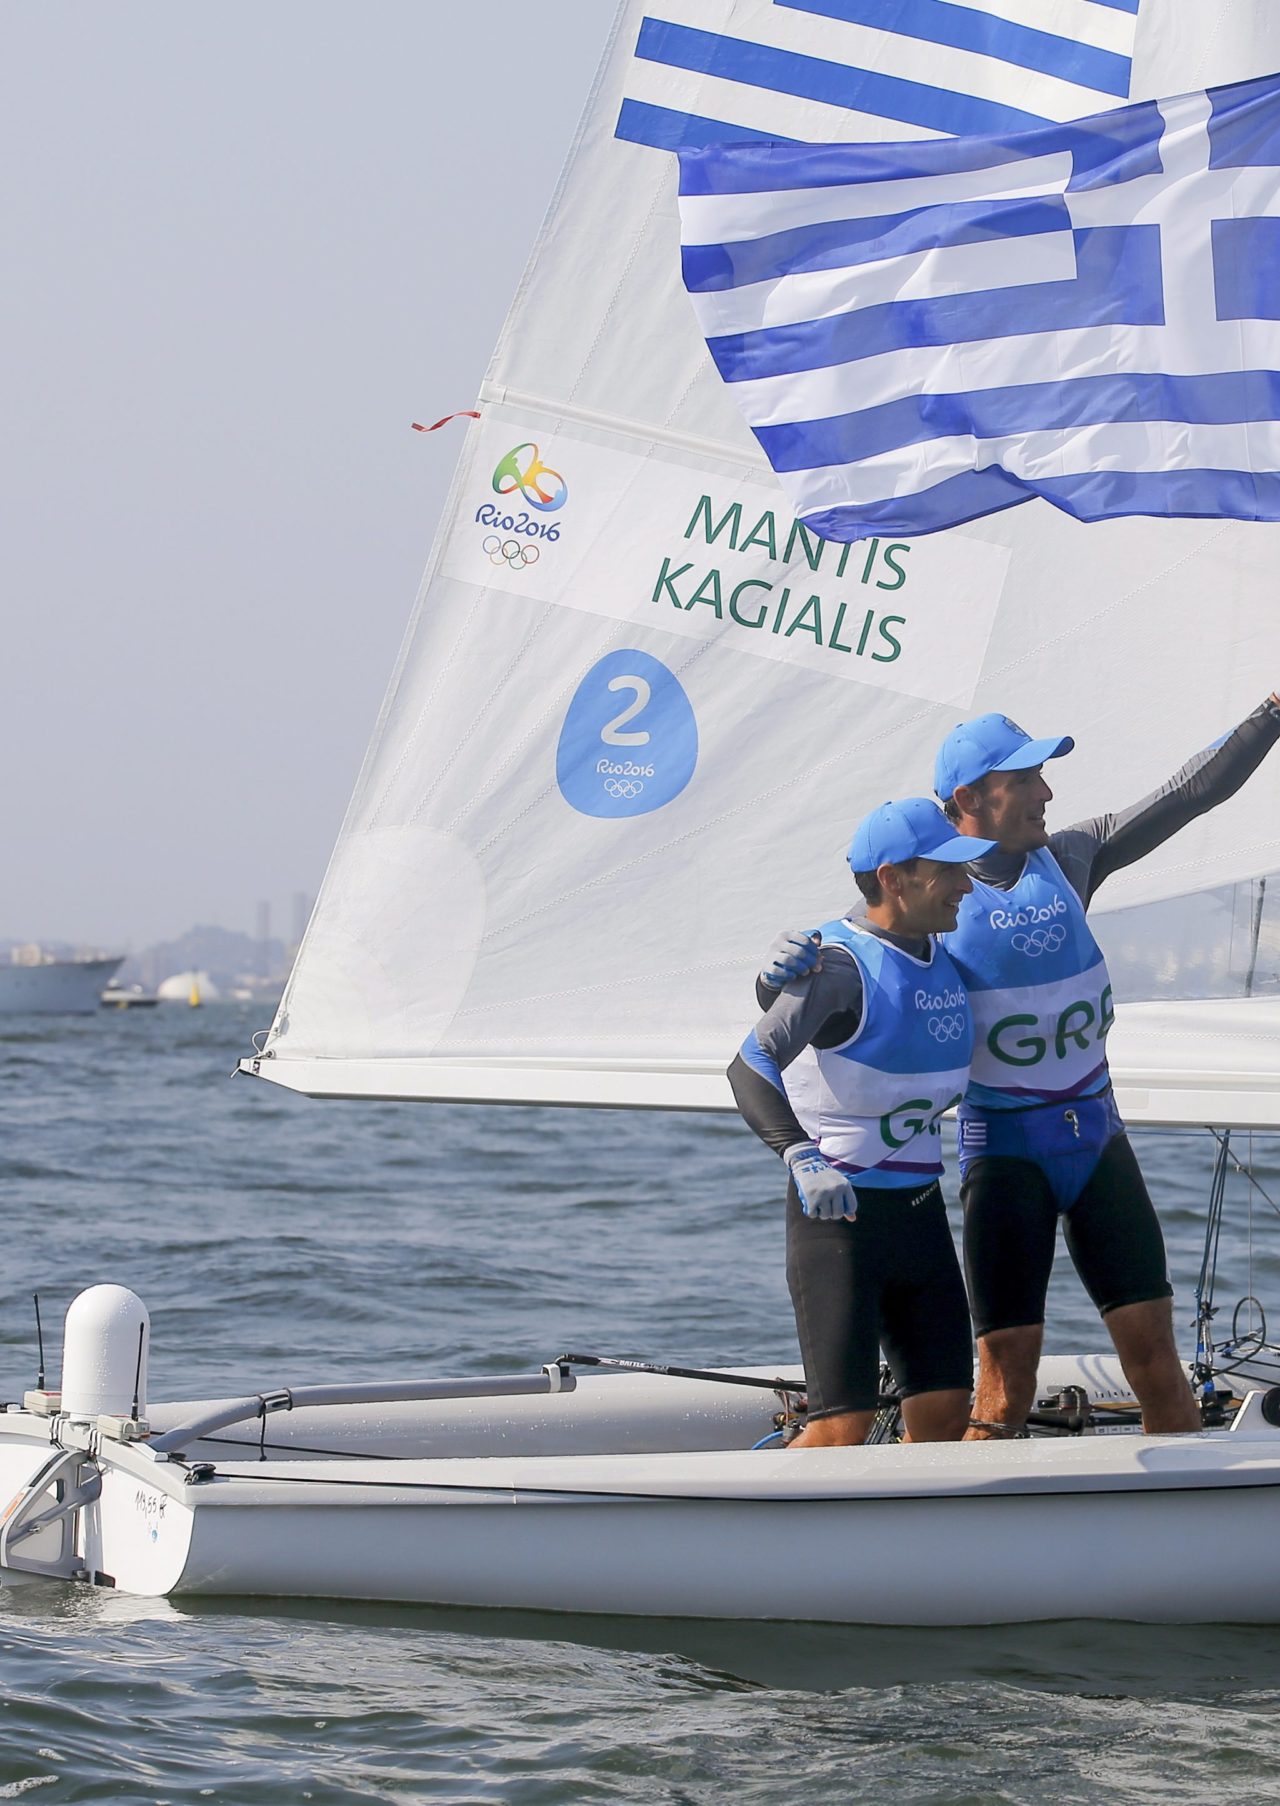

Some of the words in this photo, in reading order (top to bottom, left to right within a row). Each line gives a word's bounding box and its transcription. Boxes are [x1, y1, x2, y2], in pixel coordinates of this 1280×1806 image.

[683, 494, 911, 591] MANTIS
[651, 556, 906, 663] KAGIALIS
[600, 674, 651, 746] 2
